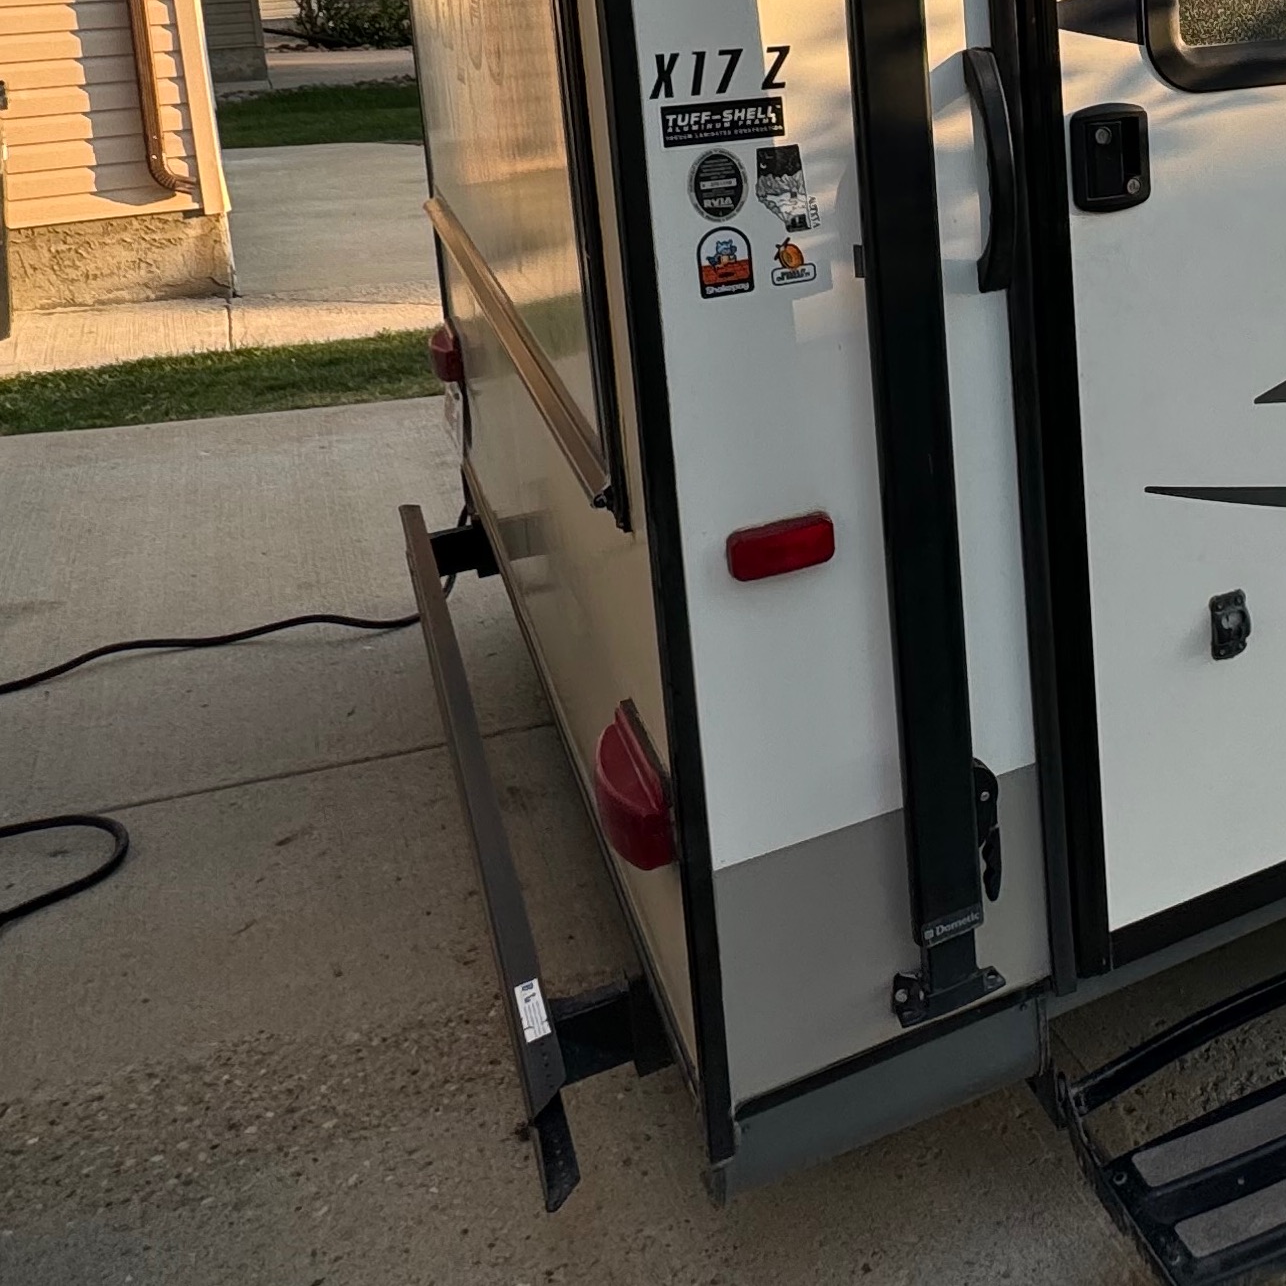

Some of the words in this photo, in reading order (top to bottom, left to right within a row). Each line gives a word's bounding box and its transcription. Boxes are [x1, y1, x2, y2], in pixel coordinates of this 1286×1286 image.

[650, 48, 744, 100] X17
[760, 45, 791, 91] Z
[665, 105, 777, 127] TUFF-SHELL
[738, 117, 776, 127] FRAM
[935, 912, 980, 937] Dometic
